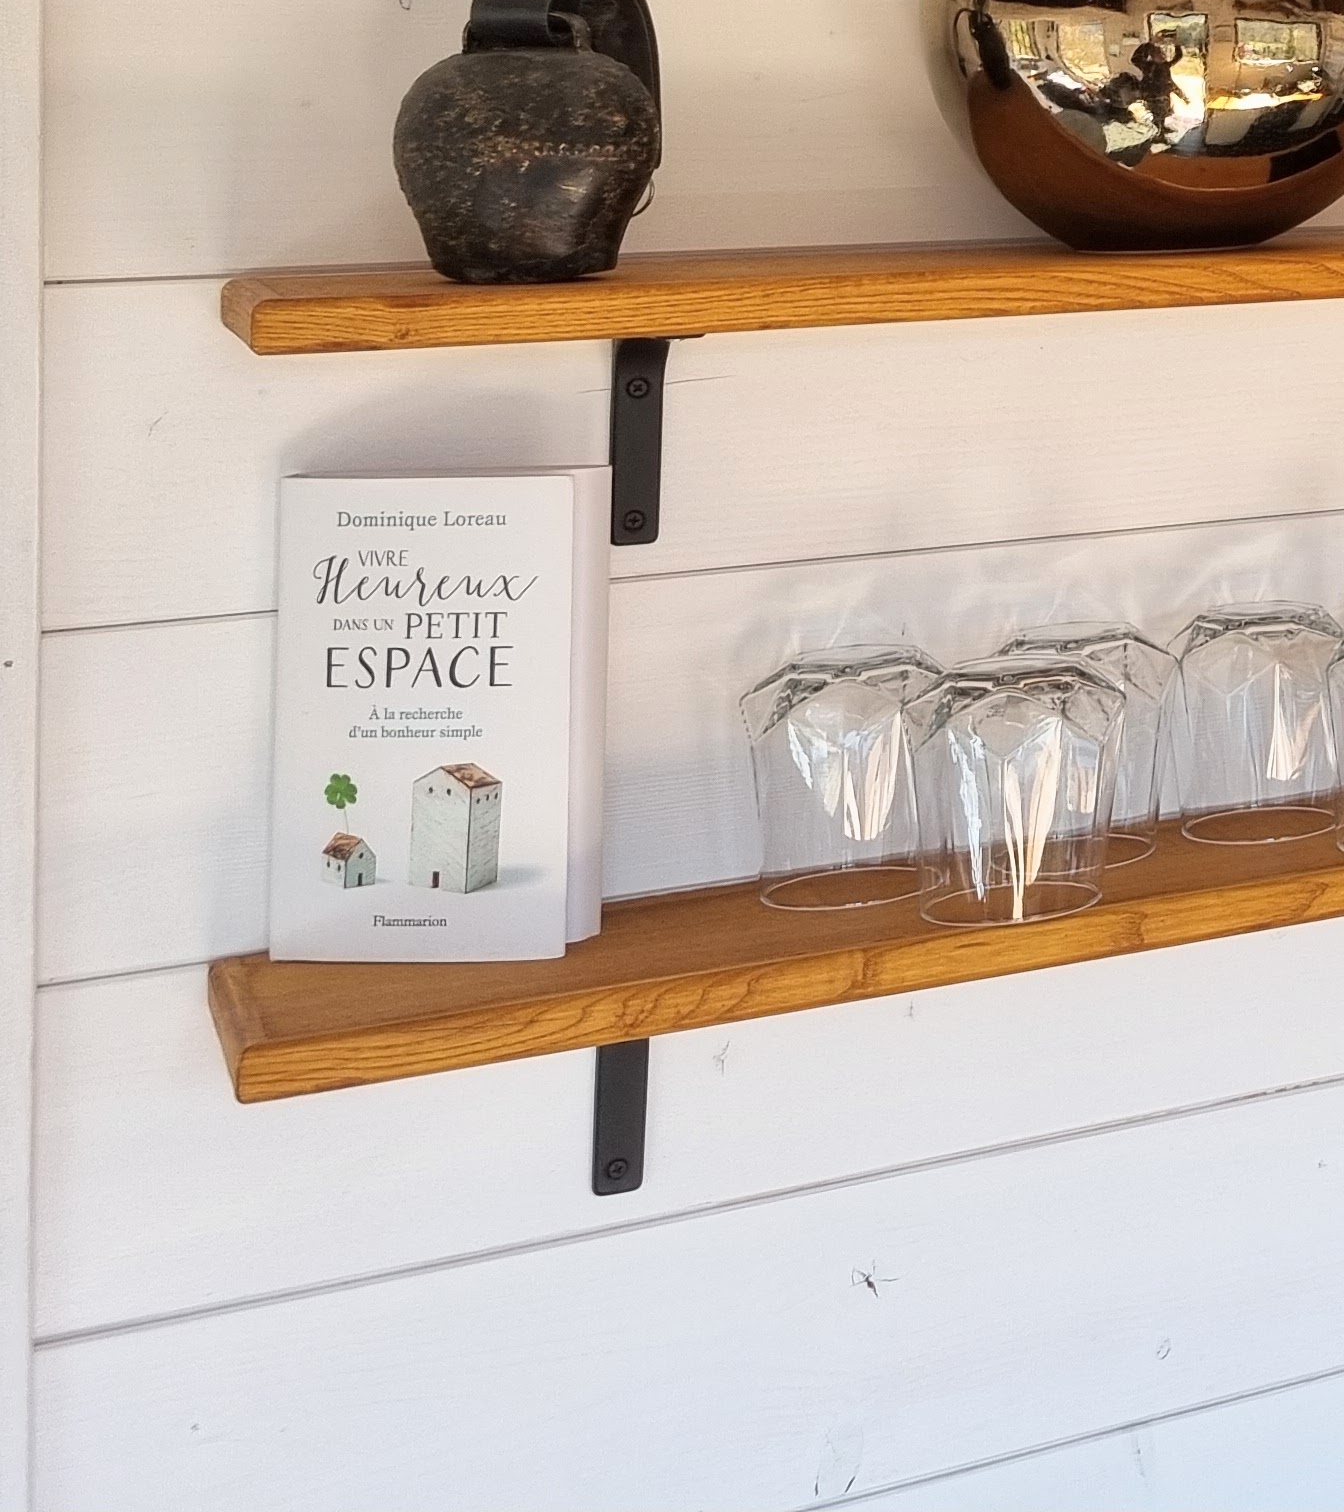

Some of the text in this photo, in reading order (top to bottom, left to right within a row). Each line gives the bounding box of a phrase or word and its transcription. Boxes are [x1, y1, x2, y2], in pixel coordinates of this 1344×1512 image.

[337, 511, 506, 531] Dominique Loreau
[358, 550, 408, 567] VIVRE
[313, 554, 539, 607] Heureux
[334, 612, 507, 639] DANS UN PETIT
[326, 646, 513, 689] ESPACE
[369, 705, 463, 720] À la recherche
[381, 726, 436, 739] bonheur
[439, 725, 483, 741] simple
[373, 915, 447, 927] Flammarion
